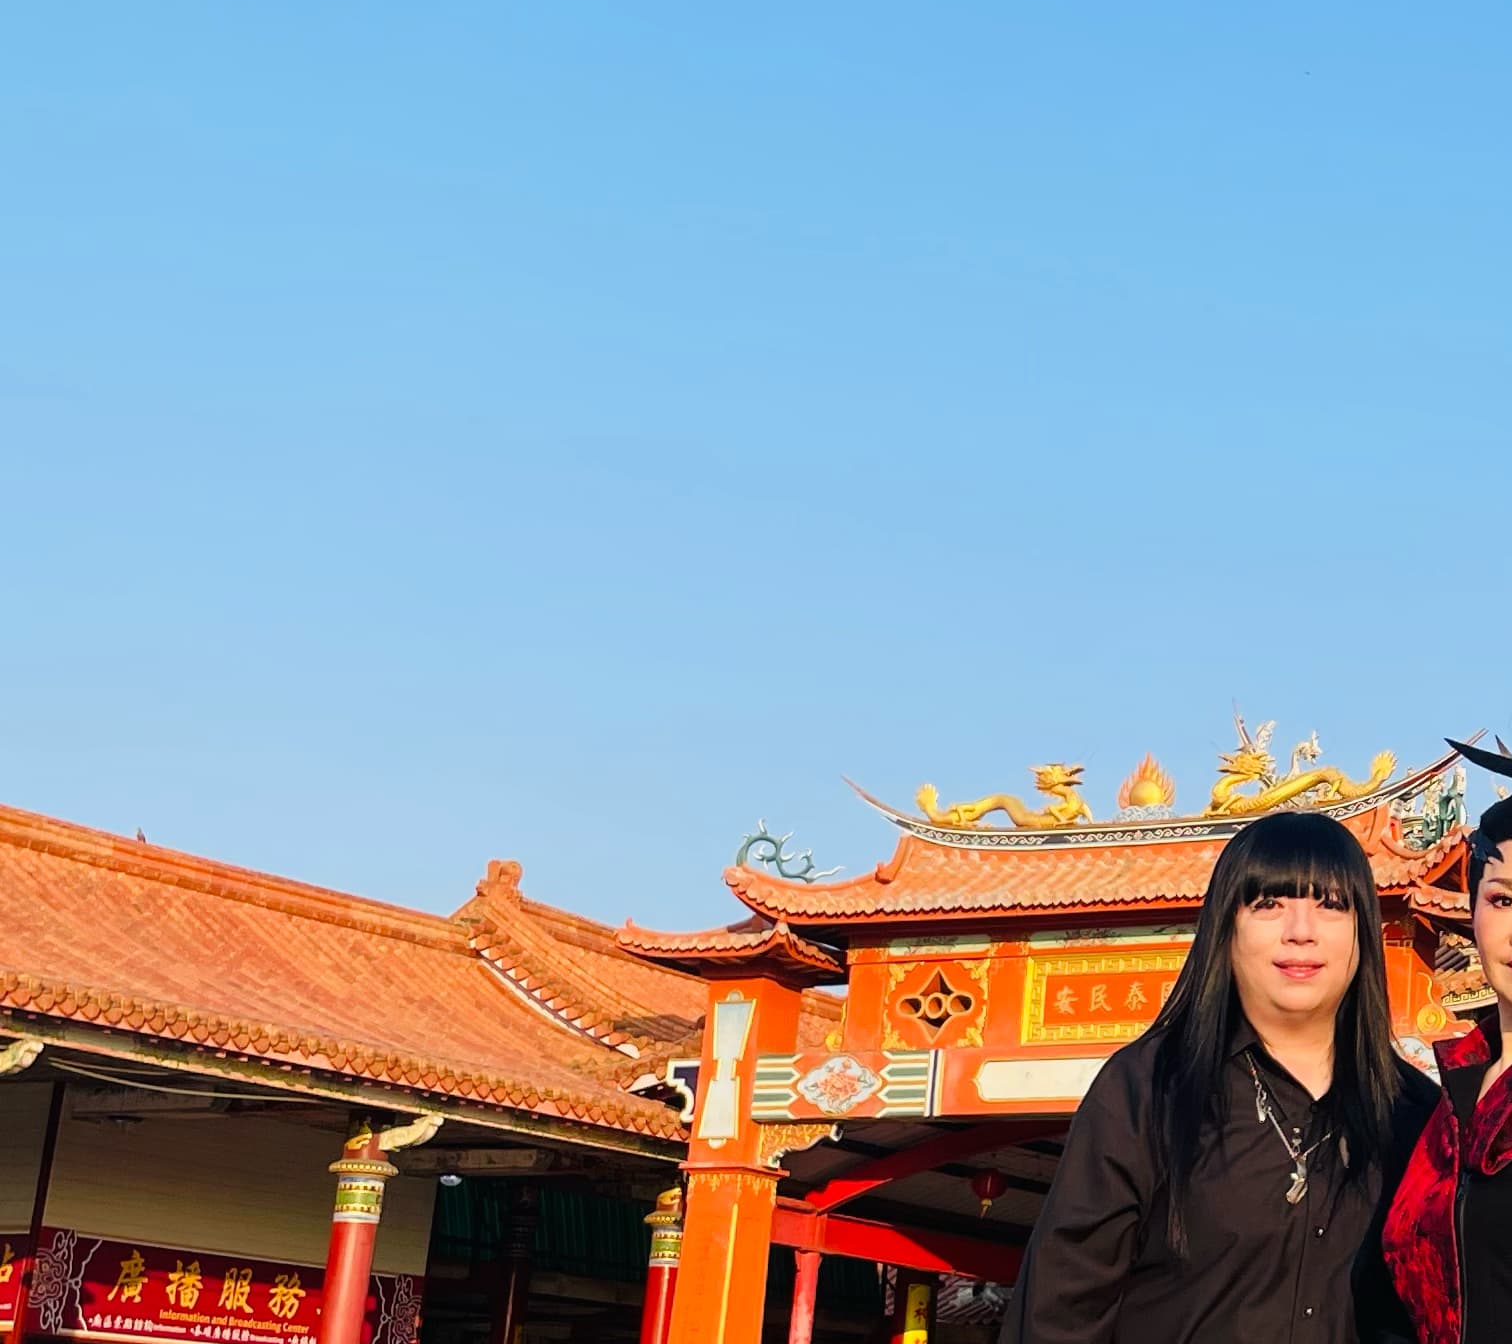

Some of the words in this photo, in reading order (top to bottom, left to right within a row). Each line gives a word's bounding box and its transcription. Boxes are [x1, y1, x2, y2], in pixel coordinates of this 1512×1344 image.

[107, 1249, 321, 1319] 廣播服務
[160, 1309, 210, 1324] Information
[211, 1315, 228, 1325] and
[229, 1316, 281, 1333] Broadcasting
[283, 1322, 310, 1334] Center
